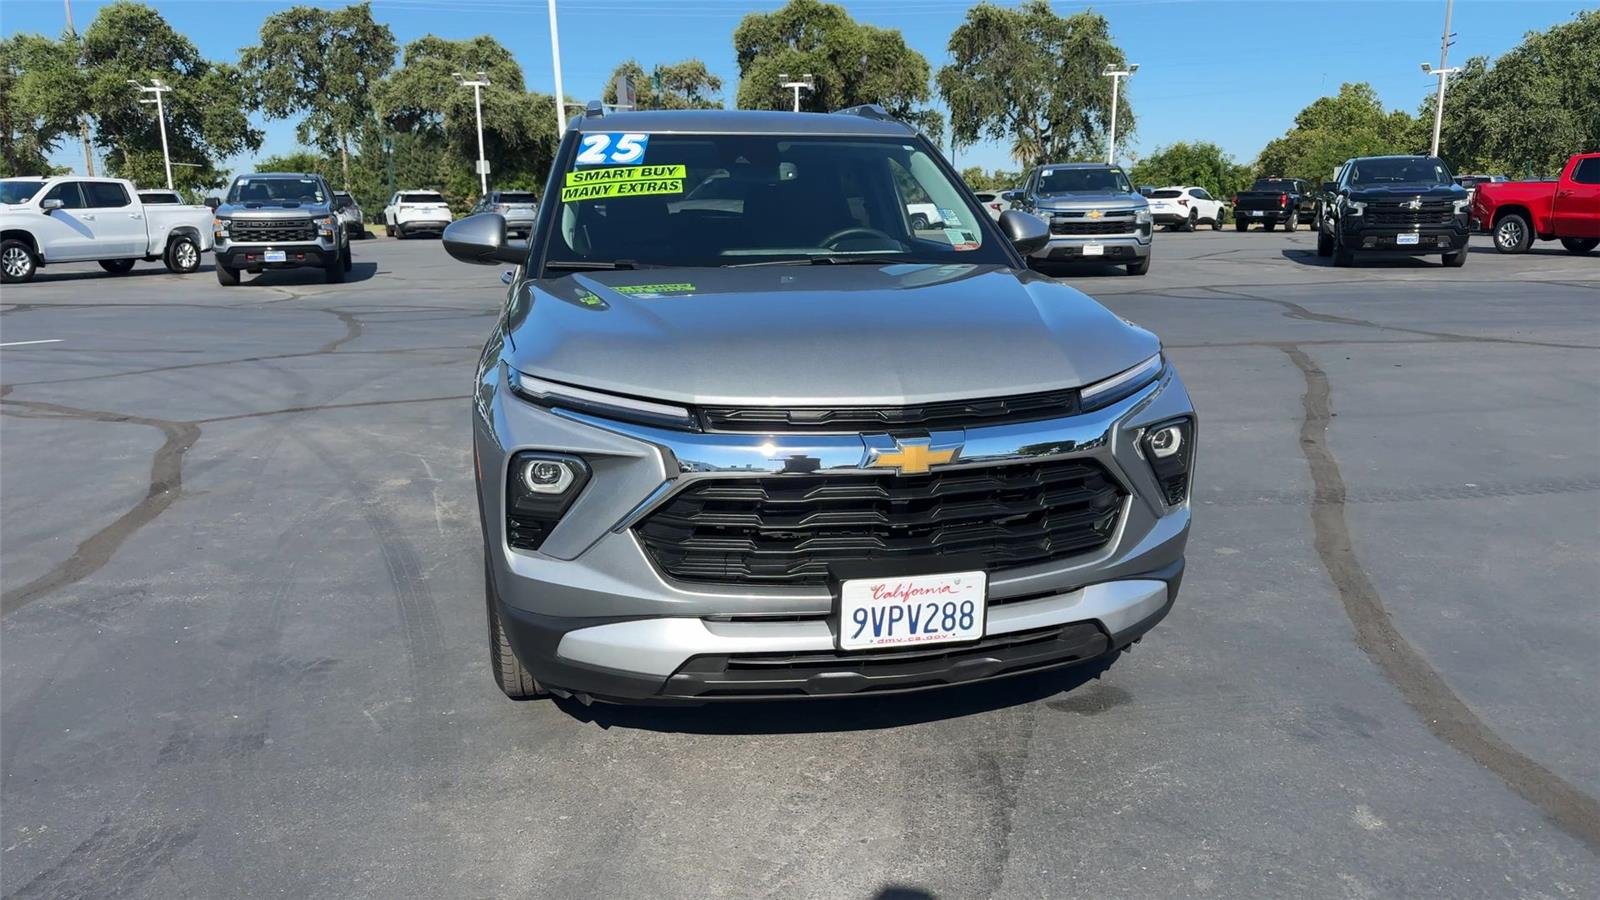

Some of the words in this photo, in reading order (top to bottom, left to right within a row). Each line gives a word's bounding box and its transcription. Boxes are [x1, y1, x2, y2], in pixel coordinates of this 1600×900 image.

[577, 134, 648, 163] 25
[573, 168, 635, 182] SMART
[641, 167, 679, 177] BUY
[564, 185, 612, 199] MANY
[617, 181, 680, 194] EXTRAS
[873, 583, 958, 603] California
[851, 600, 975, 640] 9VPV288
